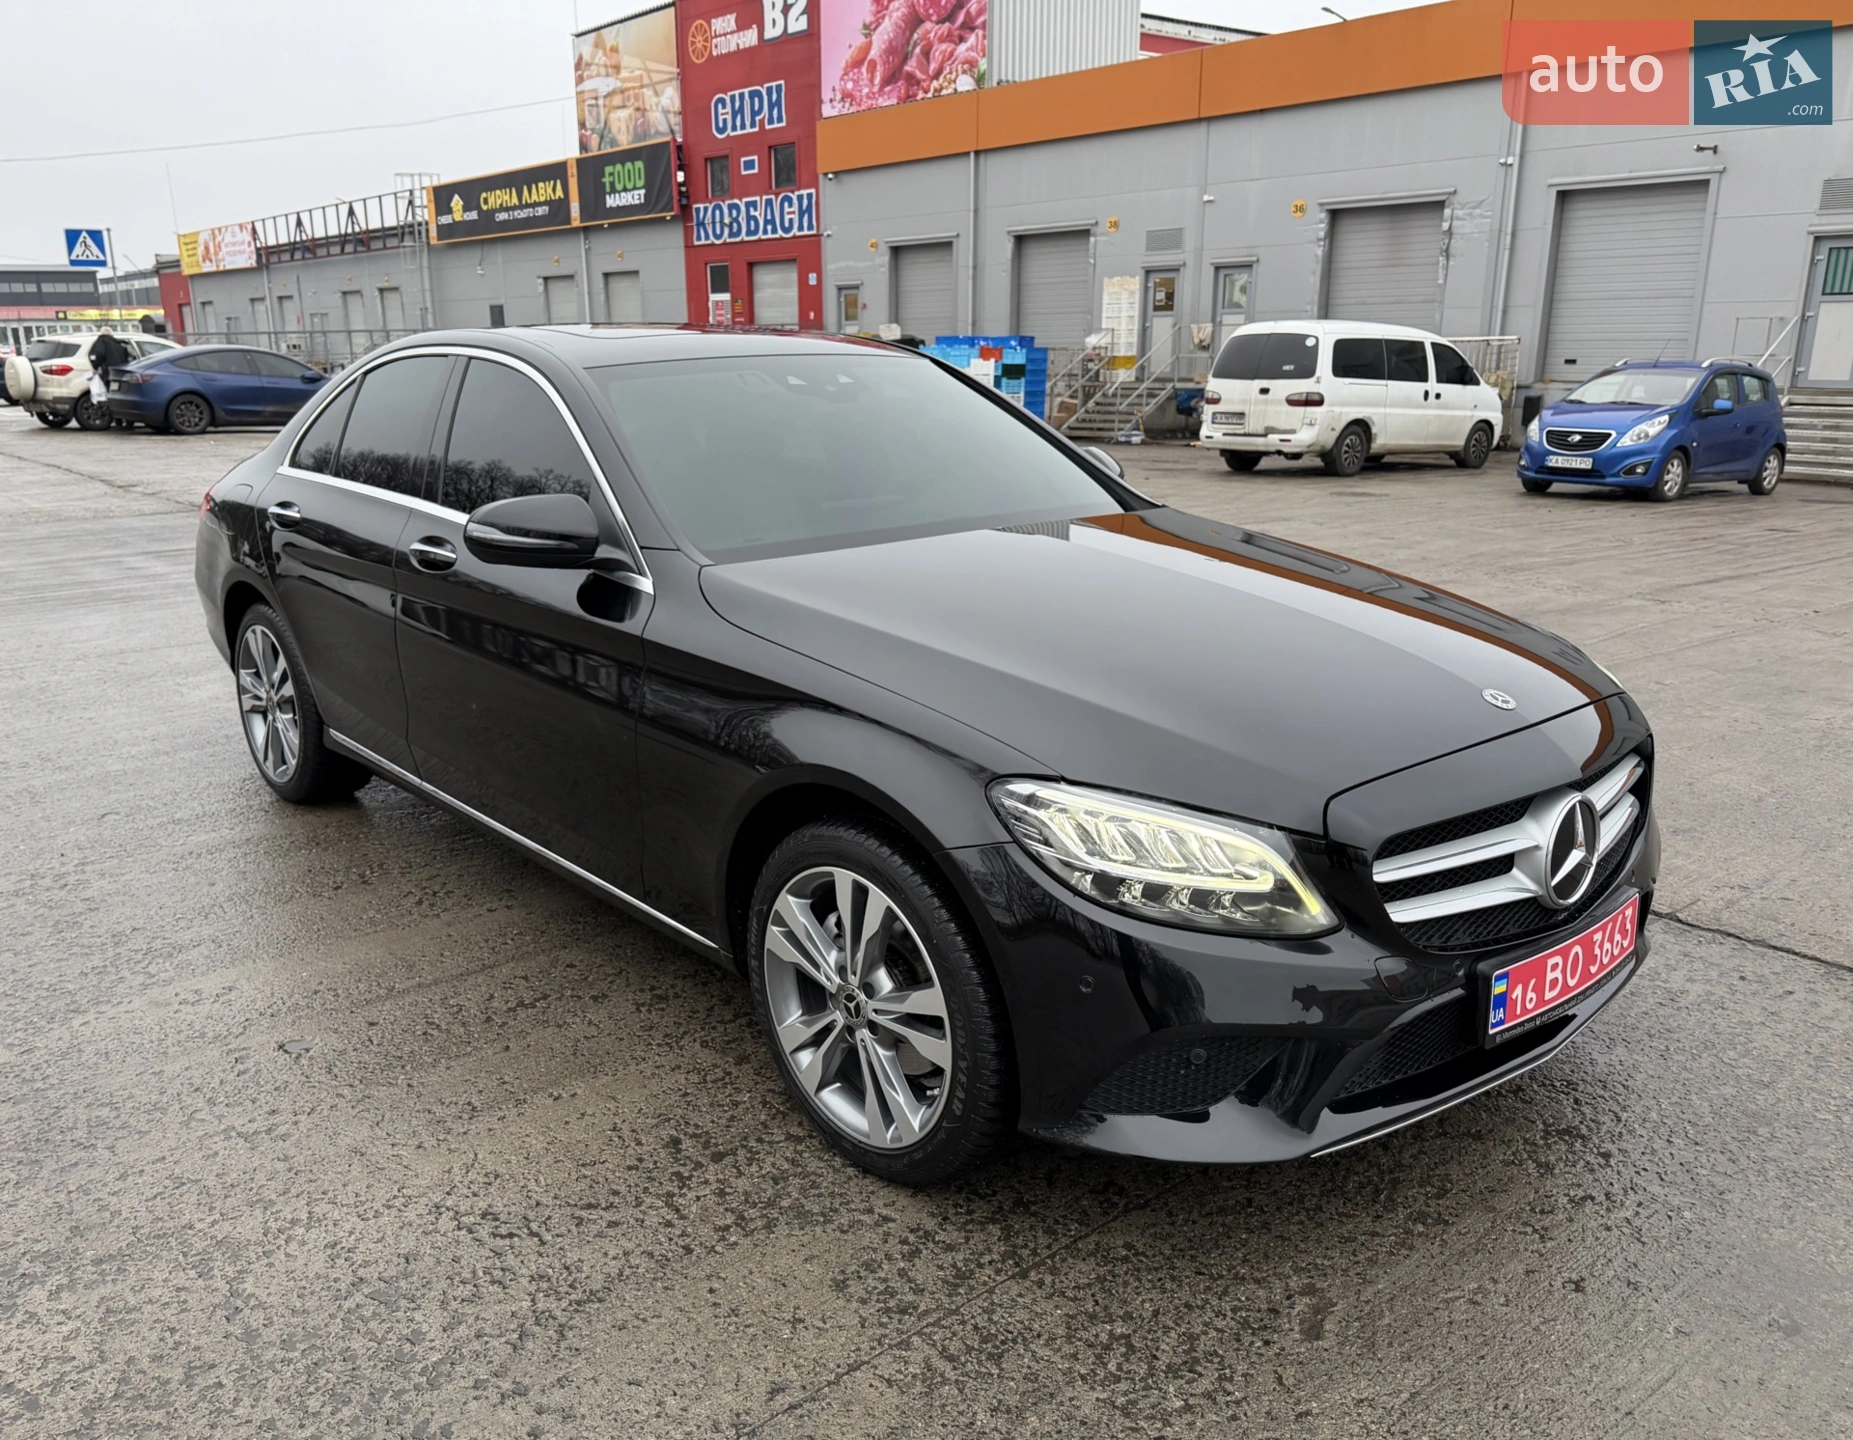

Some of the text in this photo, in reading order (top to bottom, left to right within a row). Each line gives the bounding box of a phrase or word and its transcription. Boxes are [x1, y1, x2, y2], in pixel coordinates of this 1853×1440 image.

[711, 12, 737, 36] РИНОК
[712, 24, 759, 56] СТОЛИЧНИЙ
[711, 80, 786, 138] СИРИ
[601, 160, 645, 192] FOOD
[479, 179, 564, 211] СИРНА ЛАВКА
[605, 189, 646, 208] MARKET
[1292, 203, 1305, 214] 36
[463, 209, 479, 221] HOUSE
[692, 189, 817, 245] КОВБАСИ
[1550, 456, 1591, 467] KA 0921 PO
[1510, 978, 1537, 1015] 16
[1544, 944, 1584, 1001] BO
[1589, 906, 1633, 974] 3663
[1491, 1007, 1504, 1023] UA
